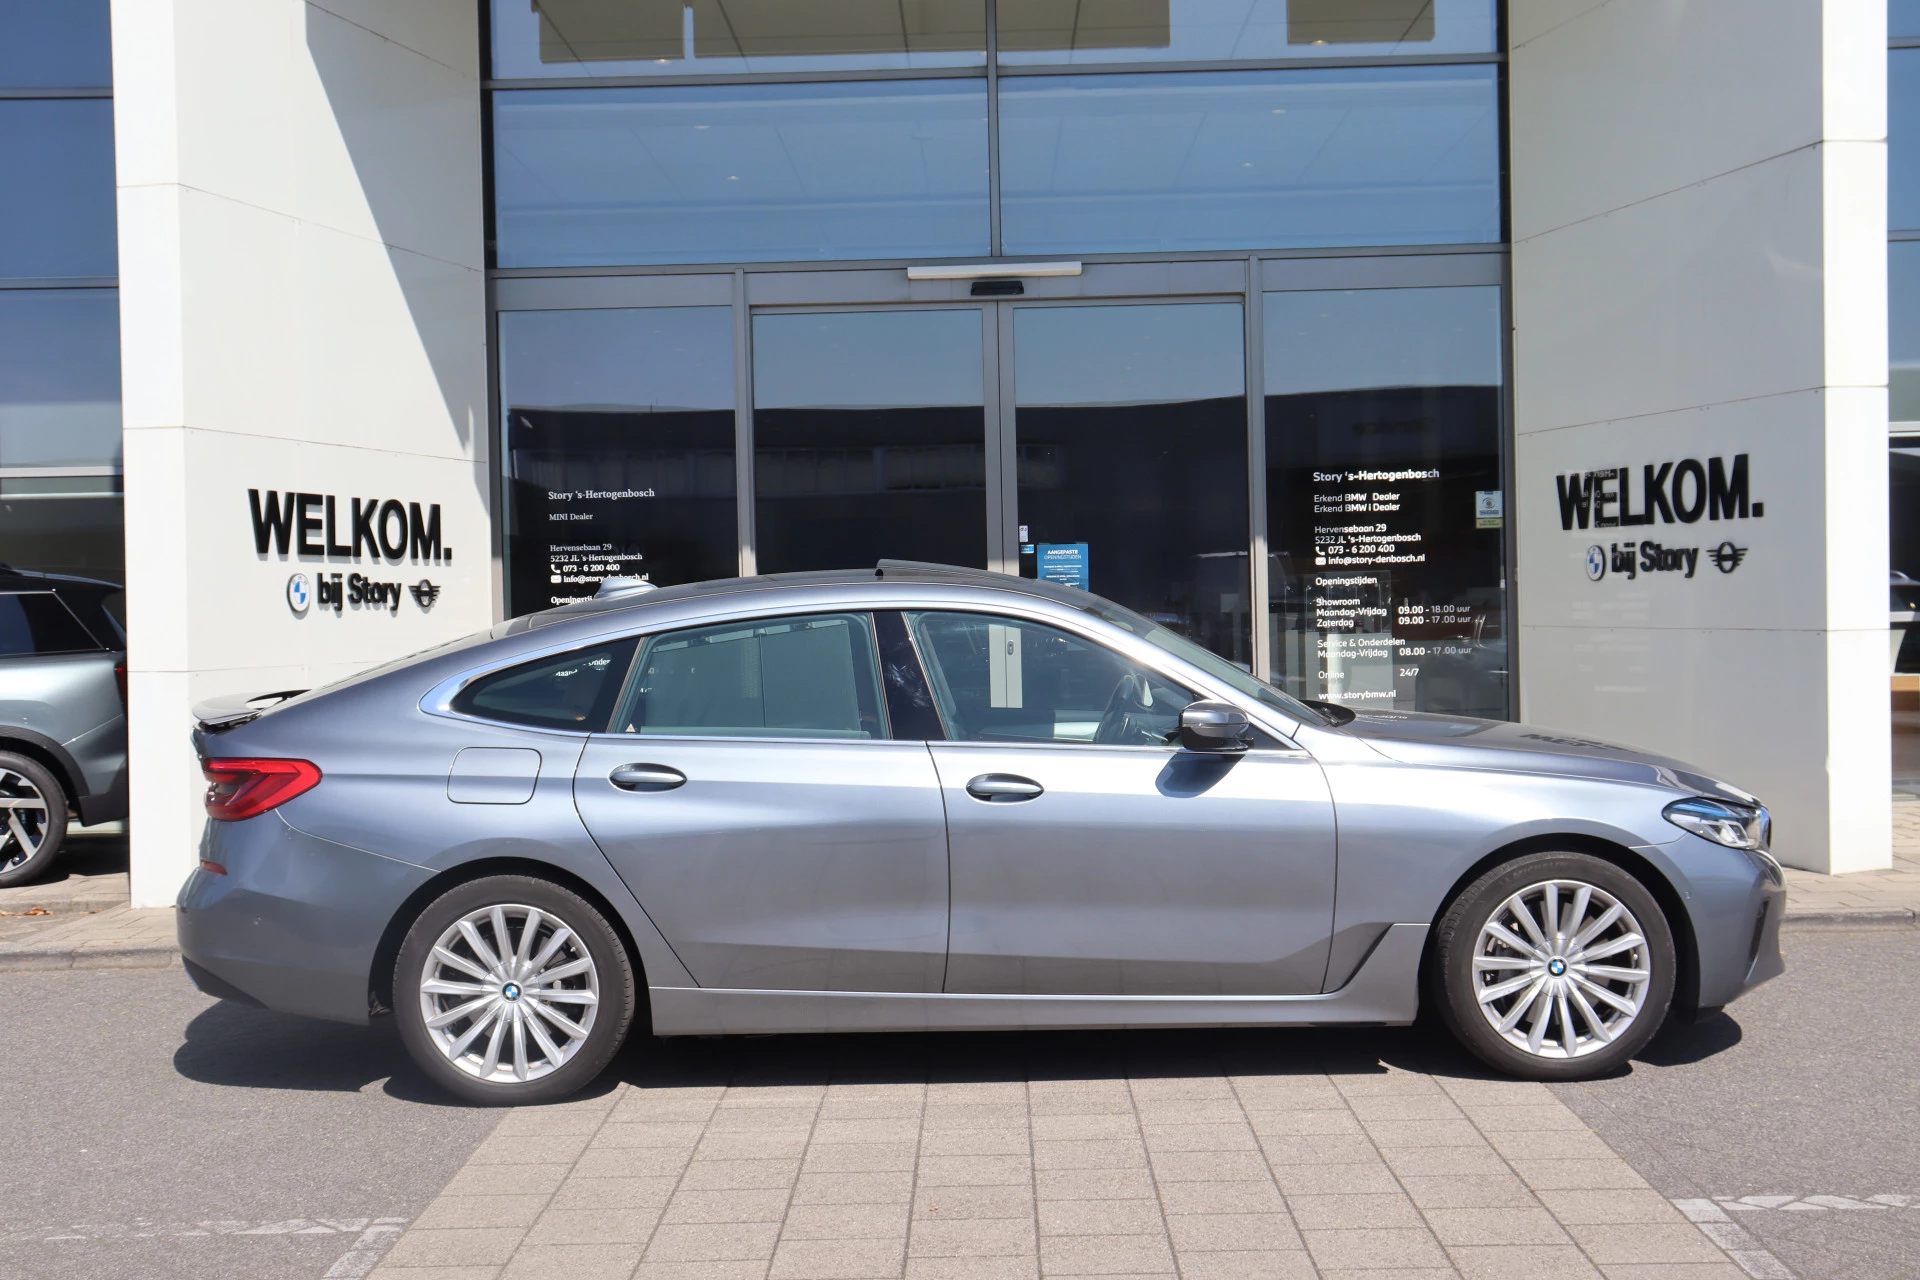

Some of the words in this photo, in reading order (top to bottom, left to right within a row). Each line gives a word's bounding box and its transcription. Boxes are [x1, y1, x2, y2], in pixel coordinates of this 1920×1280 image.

[1313, 472, 1342, 482] Story
[1344, 469, 1440, 482] 's-Hertogenbosch
[548, 491, 573, 501] Story
[575, 488, 655, 500] 's-Hertogenbosch
[1314, 494, 1342, 502] Erkend
[1344, 493, 1367, 502] BMW
[1372, 492, 1400, 500] Dealer
[1556, 453, 1764, 531] WELKOM.
[1314, 504, 1342, 512] Erkend
[1345, 503, 1367, 512] BMW
[1368, 503, 1372, 511] i
[1373, 503, 1400, 511] Dealer
[570, 512, 593, 520] Dealer
[248, 488, 452, 560] WELKOM.
[1314, 525, 1374, 533] Hervensebaan
[1376, 523, 1387, 532] 29
[1315, 536, 1335, 544] 5232
[1337, 536, 1346, 544] JL
[1348, 533, 1421, 544] 's-Hertogenbosch
[550, 544, 601, 552] Hervensebaan
[1328, 546, 1344, 554] 073
[1351, 545, 1357, 553] 6
[1359, 545, 1376, 553] 200
[1378, 544, 1395, 552] 400
[581, 553, 642, 562] 's-Hertogenbosch
[1328, 554, 1426, 565] info@story-denbosch.nl
[1612, 542, 1636, 580] bij
[1640, 541, 1699, 578] Story
[583, 564, 589, 572] 6
[590, 564, 604, 572] 200
[1316, 576, 1377, 586] Openingstijden
[317, 573, 343, 611] bij
[348, 572, 402, 611] Story
[1316, 598, 1360, 606] Showroom
[1316, 607, 1387, 617] Maandag-Vrijdag
[1398, 606, 1424, 614] 09.00
[1431, 605, 1454, 613] 18.00
[1317, 618, 1354, 628] Zaterdag
[1398, 616, 1424, 624] 09.00
[1317, 640, 1347, 648] Service
[1349, 639, 1356, 647] &
[1358, 638, 1405, 646] Onderdelen
[1318, 649, 1388, 659] Maandag-Vrijdag
[1399, 647, 1425, 656] 08.00
[1318, 671, 1344, 679] Online
[1400, 668, 1419, 677] 24/7
[1318, 690, 1397, 700] www.storybmw.nl
